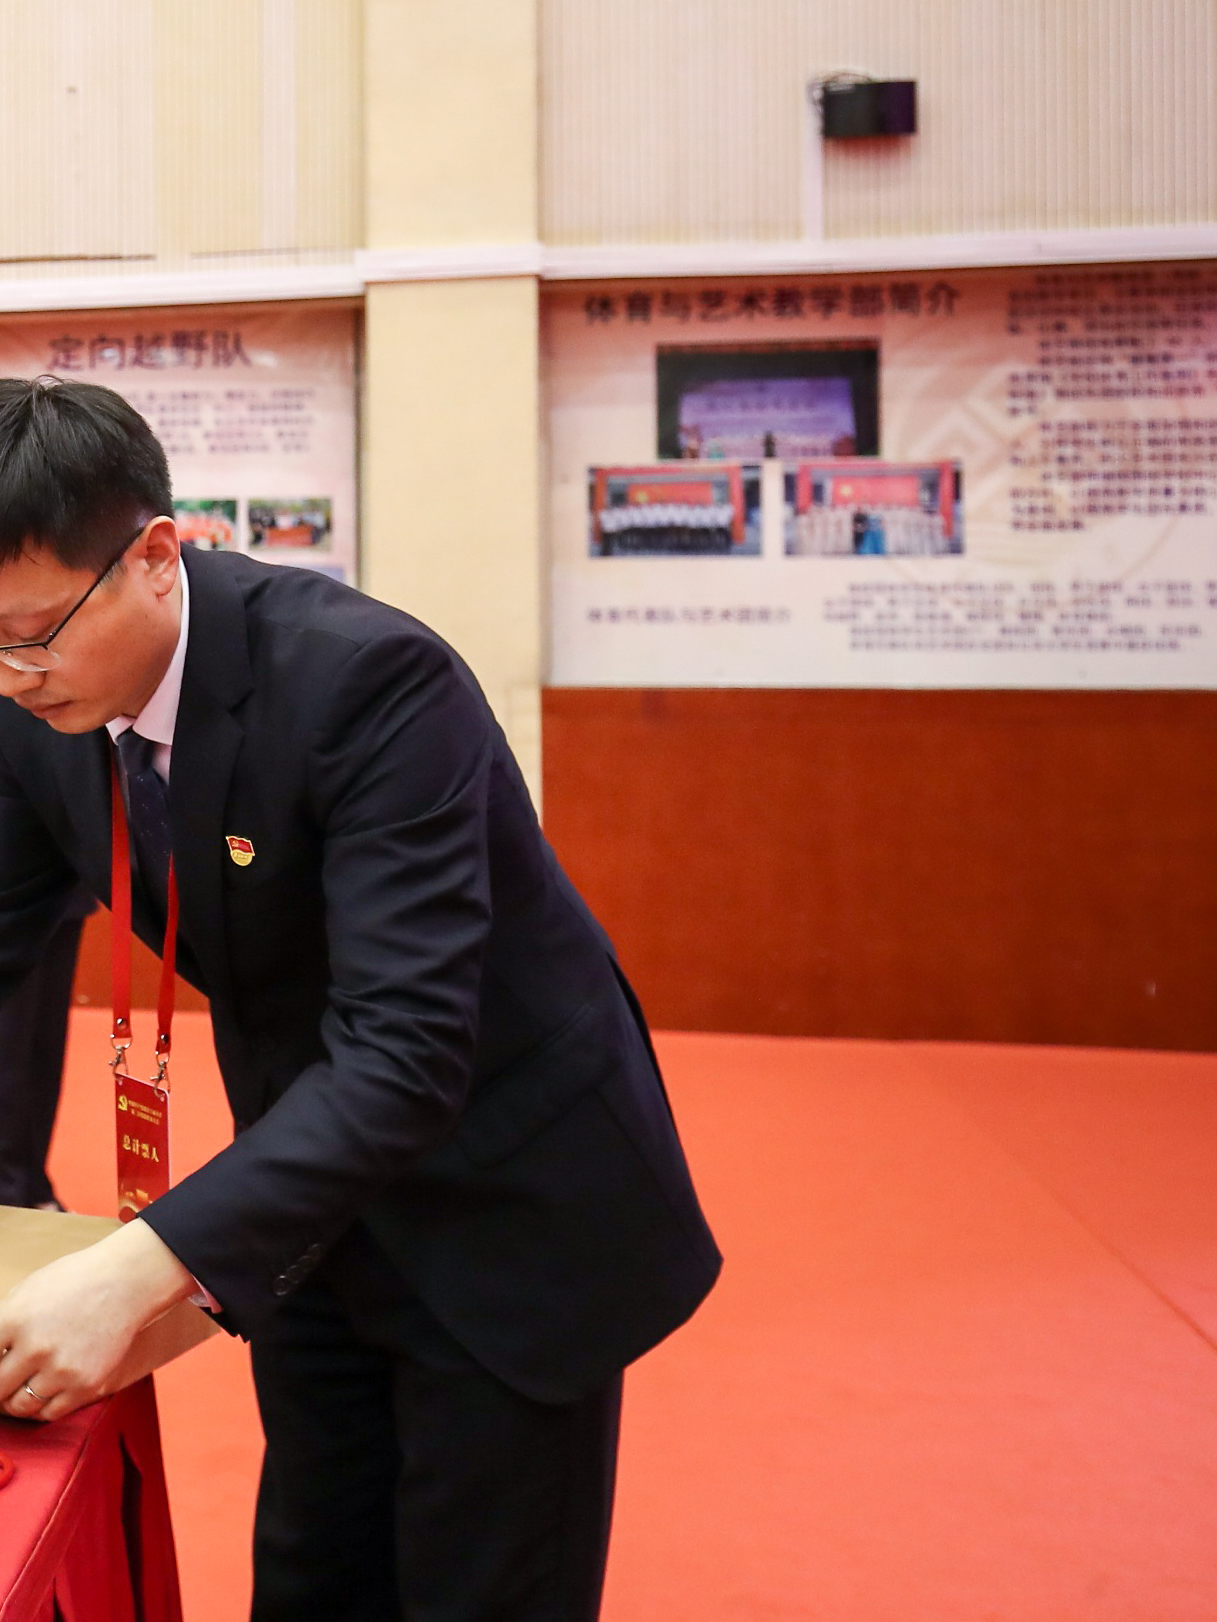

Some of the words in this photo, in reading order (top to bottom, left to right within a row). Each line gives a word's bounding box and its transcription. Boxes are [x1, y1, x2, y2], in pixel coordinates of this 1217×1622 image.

[46, 330, 252, 370] 定向越野队
